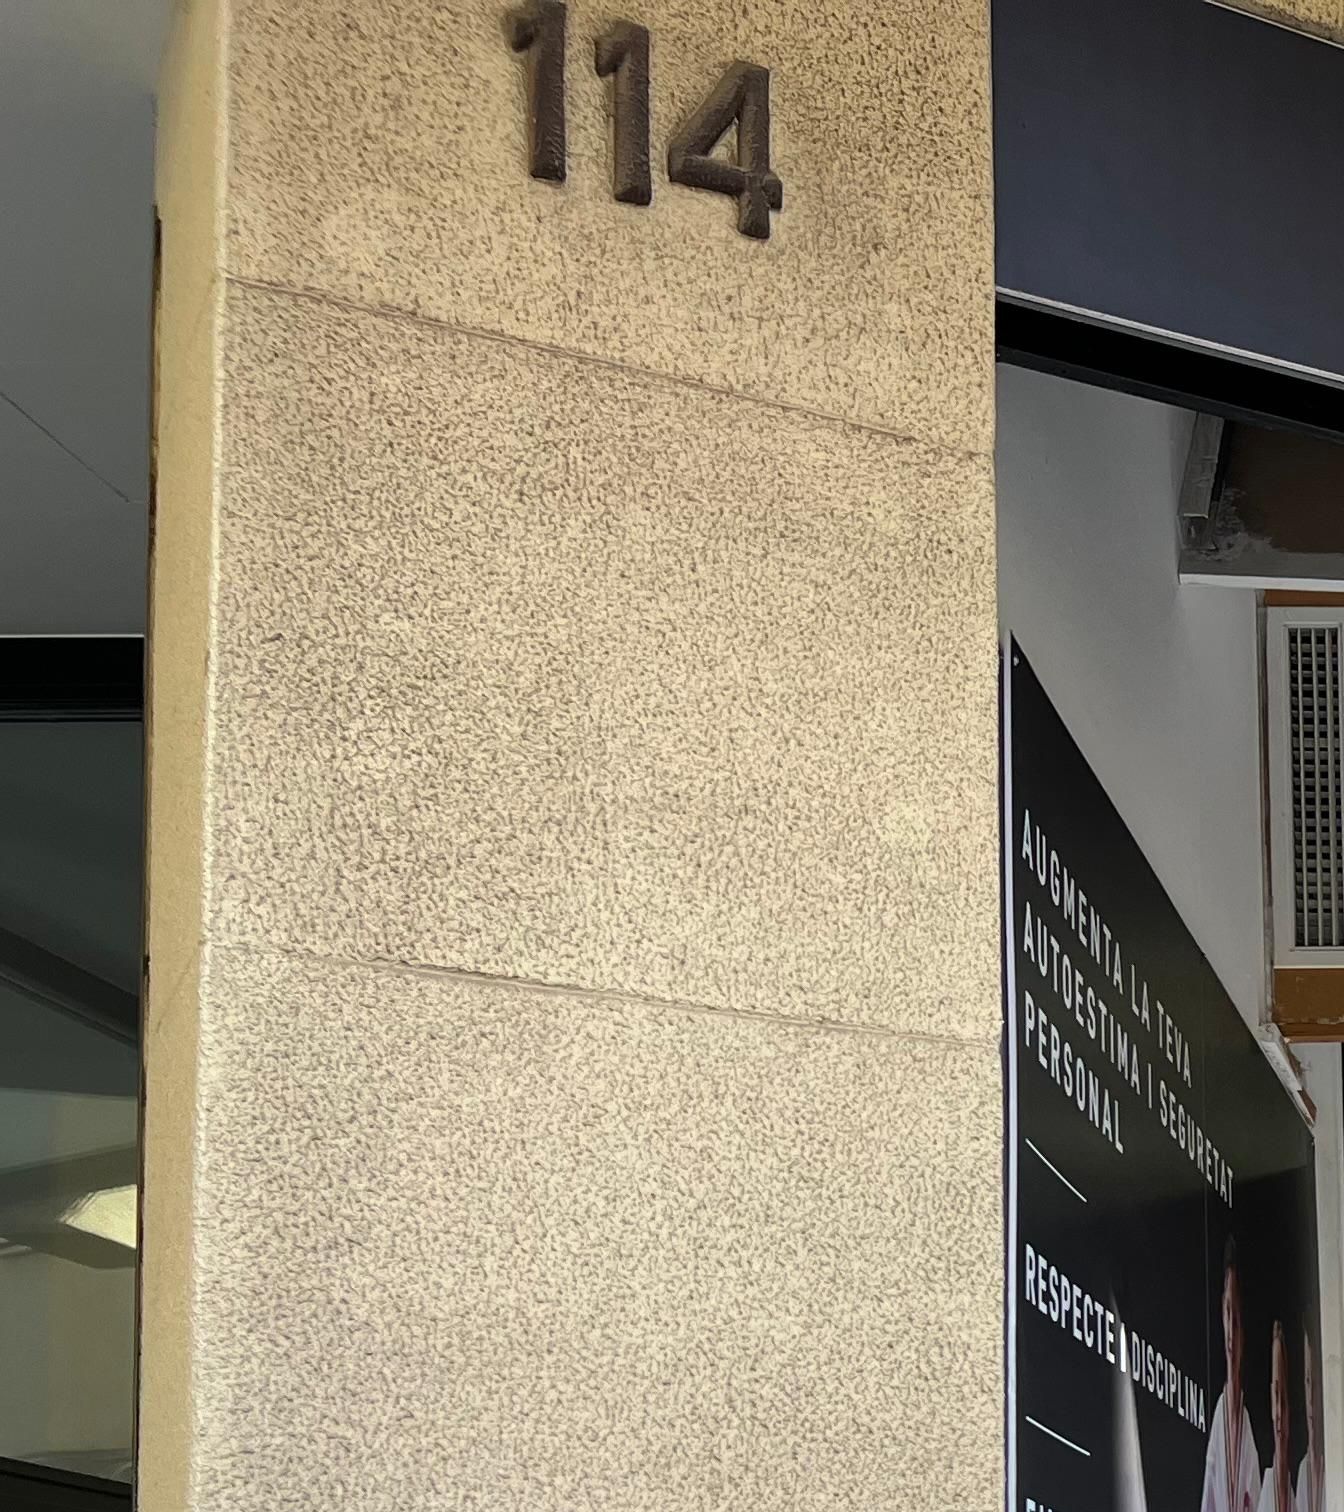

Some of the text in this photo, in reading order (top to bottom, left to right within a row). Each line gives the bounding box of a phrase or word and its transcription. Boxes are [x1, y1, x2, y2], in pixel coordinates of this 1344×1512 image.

[511, 0, 782, 239] 114
[1022, 809, 1192, 1088] AUGMENTA LA TEVA
[1023, 901, 1234, 1208] AUTOESTIMA I SEGURETAT
[1024, 990, 1124, 1154] PERSONAL
[1025, 1243, 1115, 1364] RESPECTE
[1132, 1331, 1206, 1433] DISCIPLINA
